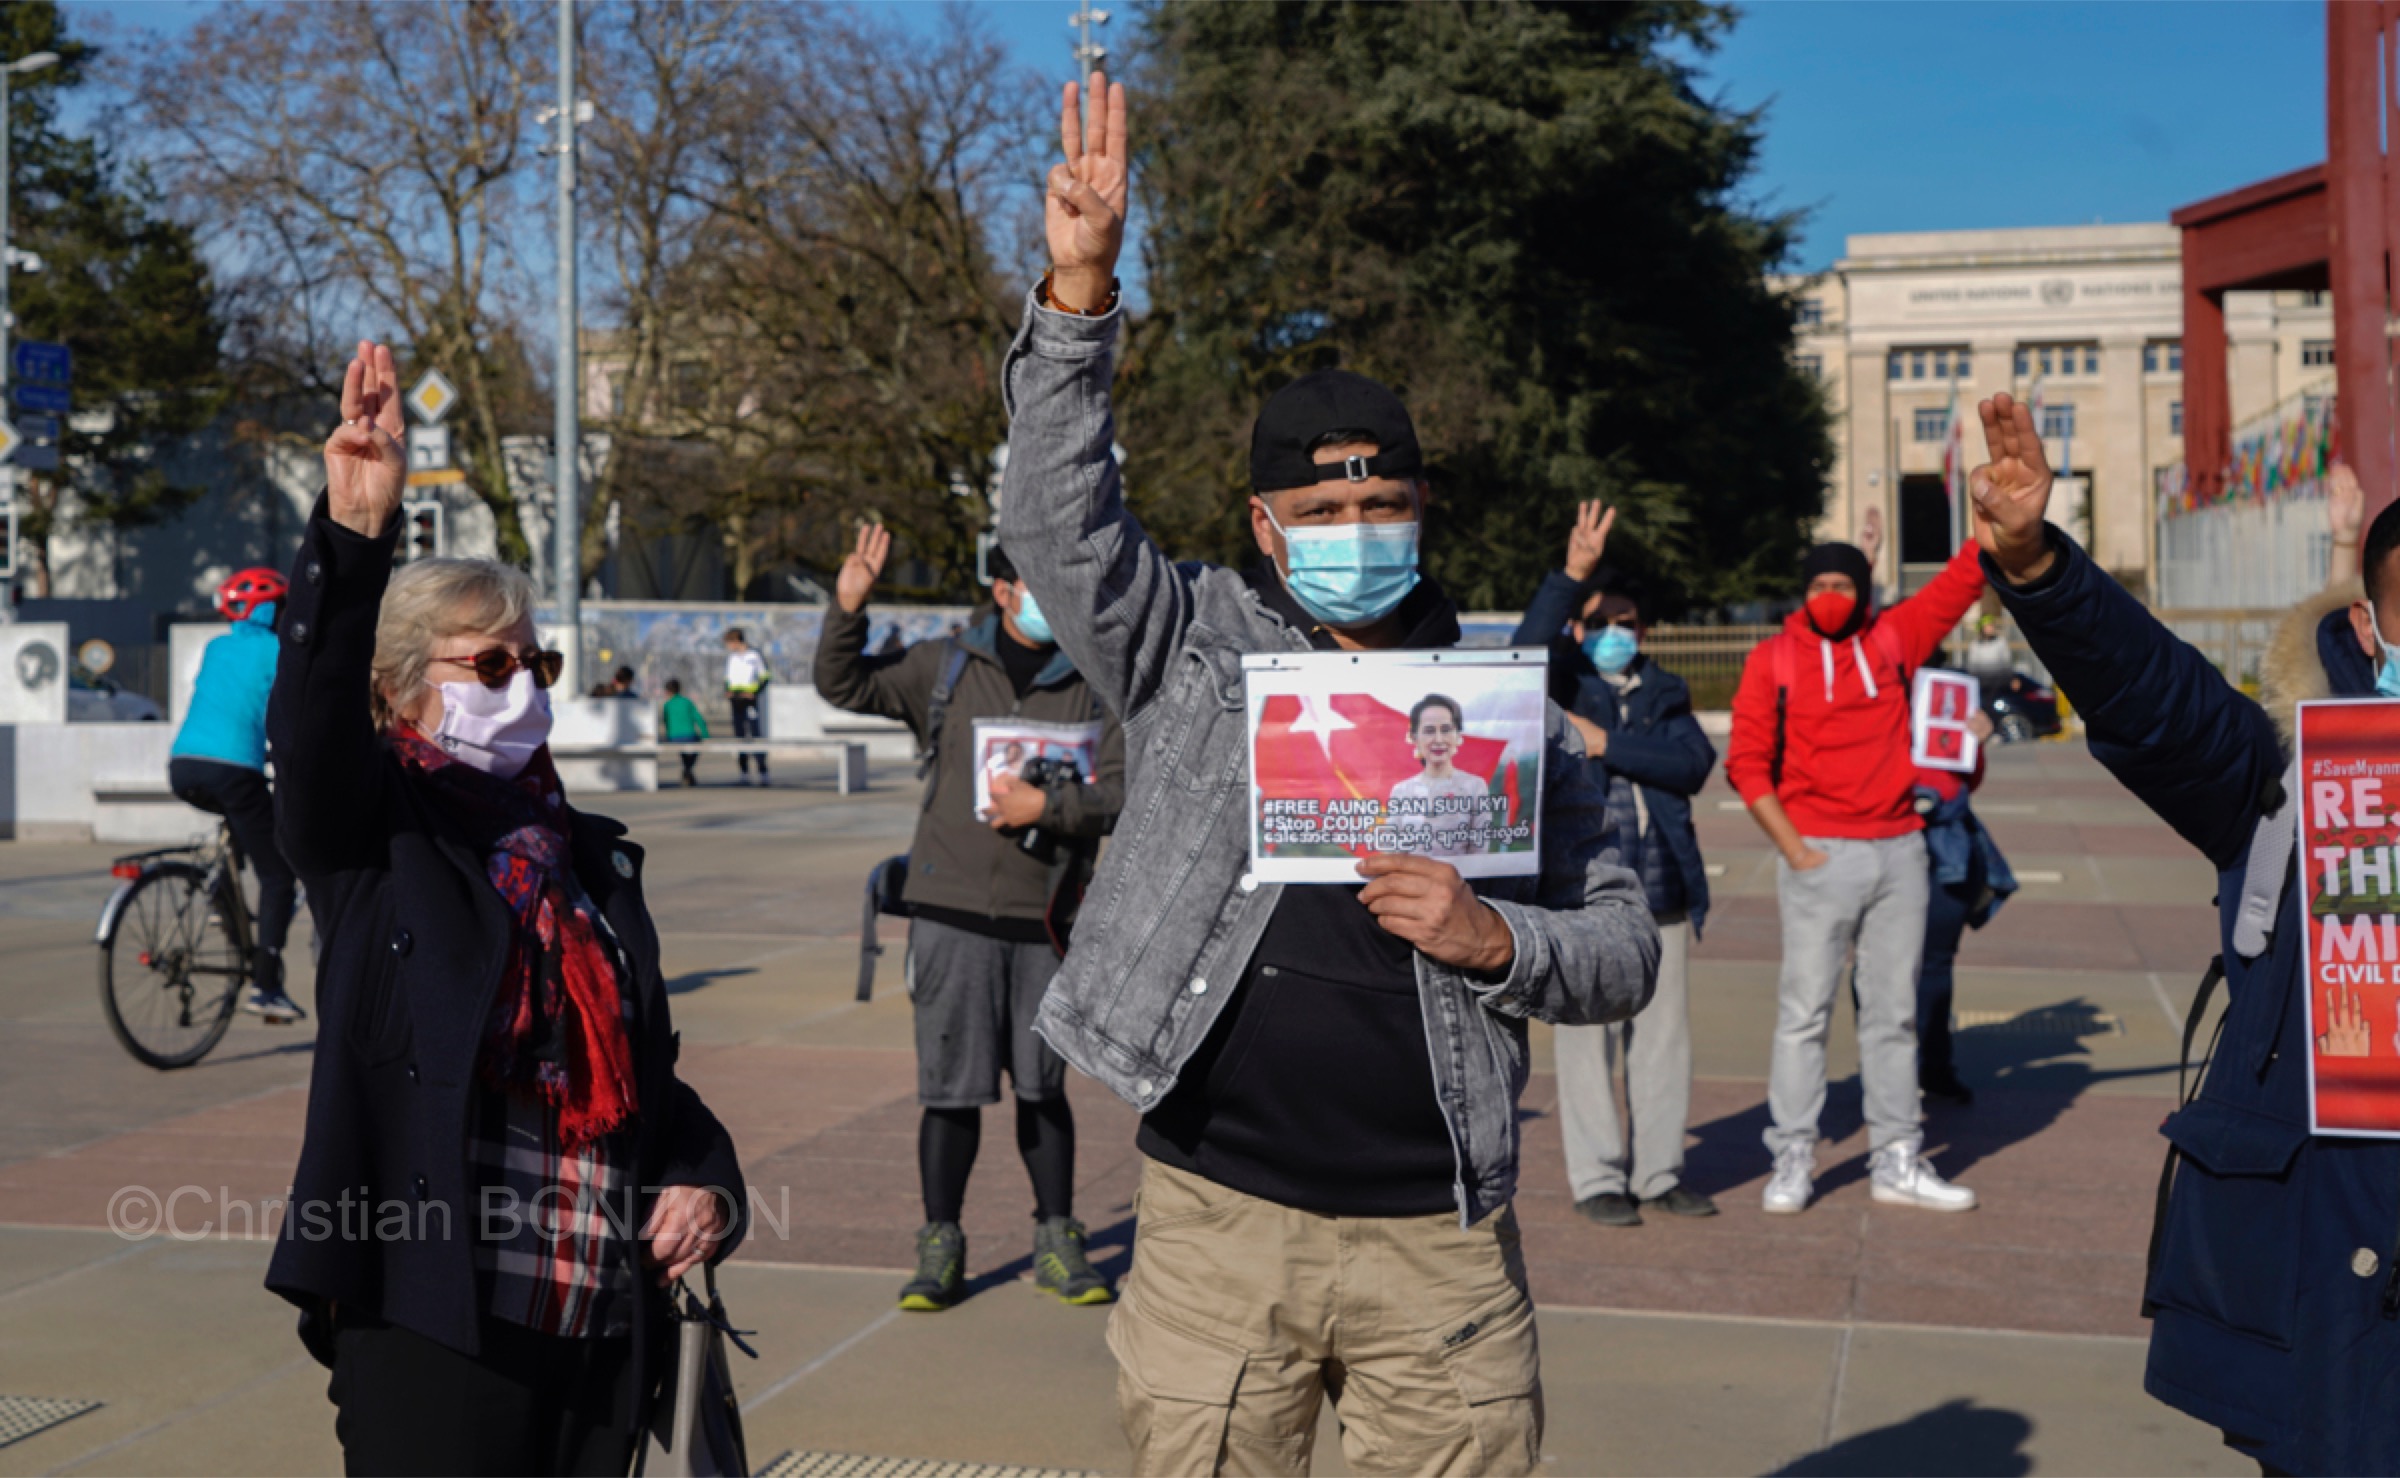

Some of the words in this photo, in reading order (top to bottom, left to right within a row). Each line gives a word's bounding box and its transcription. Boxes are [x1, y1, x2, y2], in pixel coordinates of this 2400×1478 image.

[1263, 799, 1319, 815] #FREE
[1327, 799, 1380, 815] AUNG
[1387, 798, 1425, 815] SAN
[1435, 797, 1471, 814] SUU
[1479, 795, 1508, 812] KYI
[1263, 815, 1317, 832] #Stop
[1323, 815, 1376, 831] COUP
[2320, 963, 2385, 984] CIVIL
